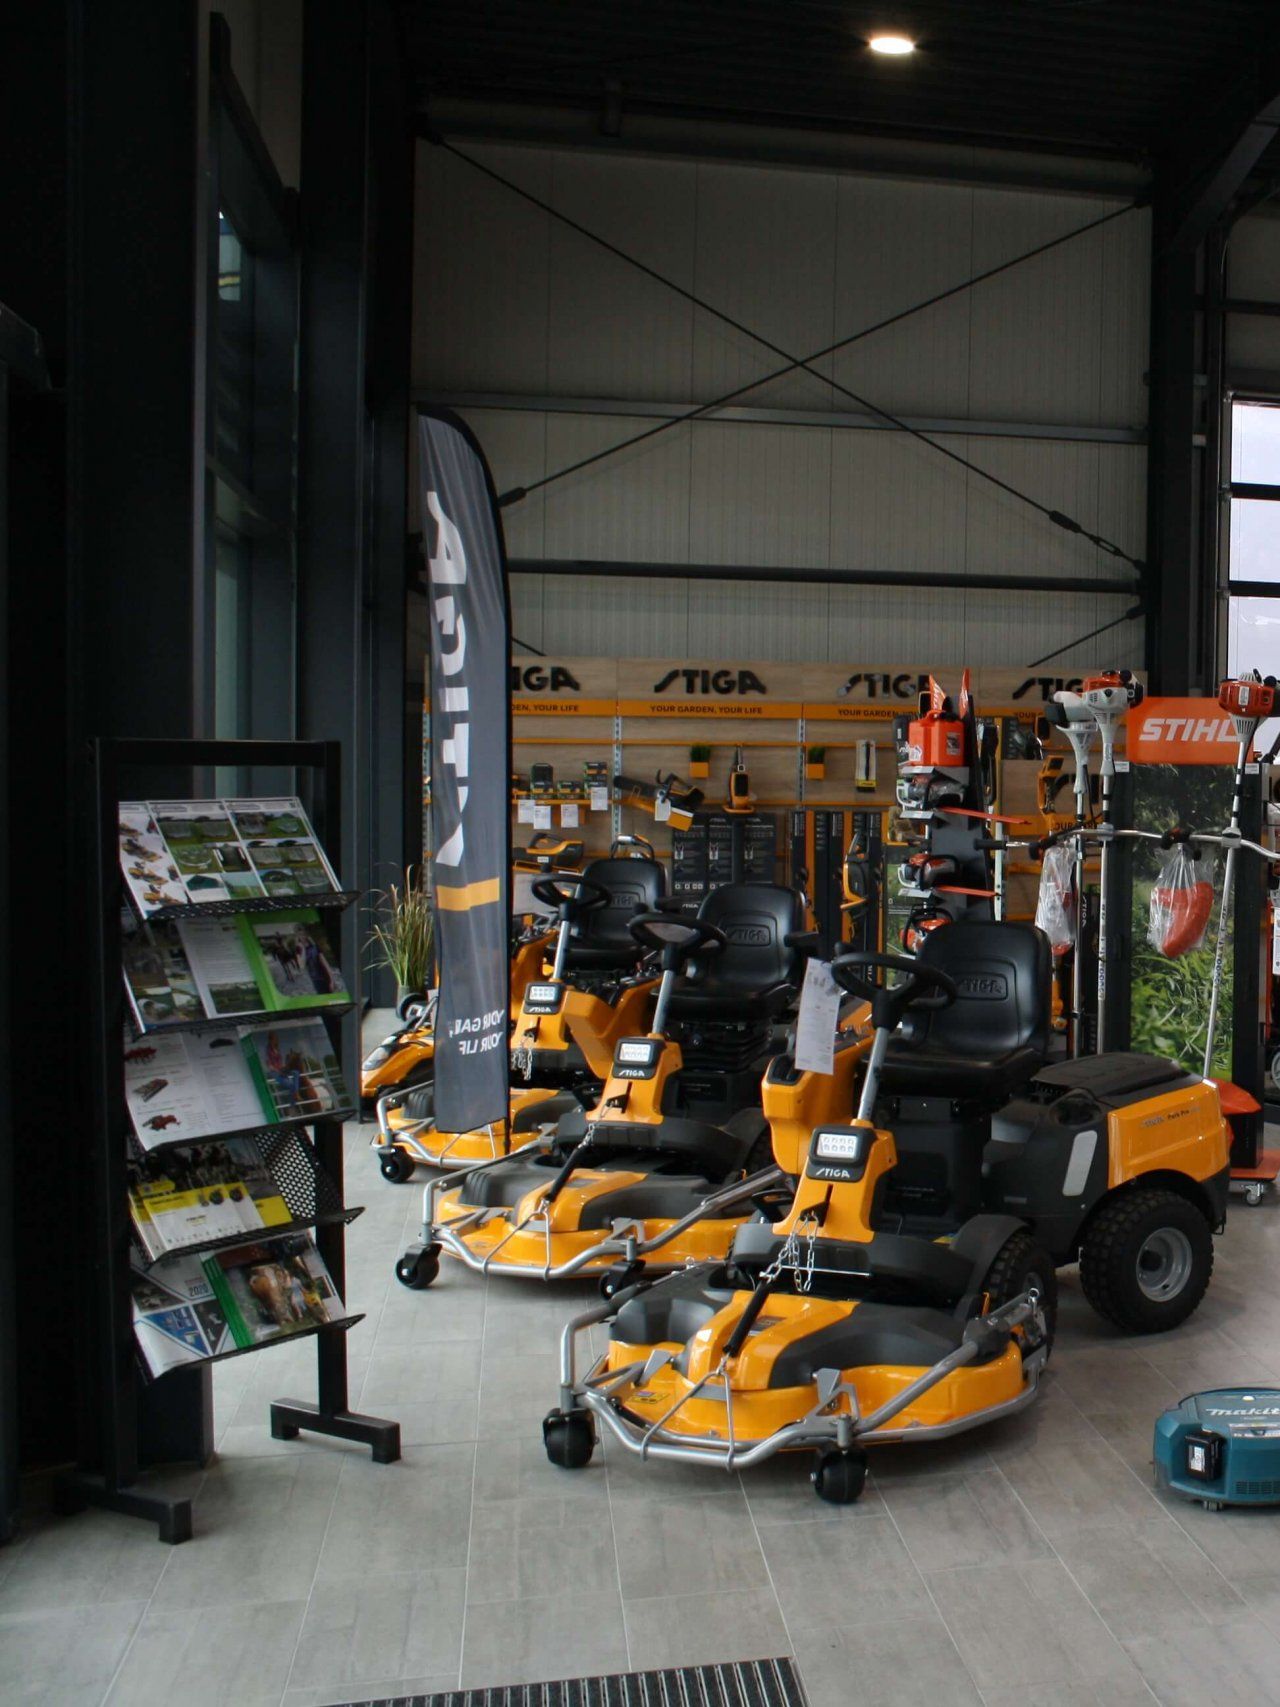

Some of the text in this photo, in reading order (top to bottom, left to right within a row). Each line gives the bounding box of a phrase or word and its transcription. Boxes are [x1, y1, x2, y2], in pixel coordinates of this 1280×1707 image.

[512, 666, 580, 691] IGA
[654, 669, 766, 695] STIGA
[1013, 676, 1084, 700] STIG
[512, 704, 531, 713] DEN,
[534, 704, 558, 712] YOUR
[651, 704, 762, 715] YOUR GARDEN, YOUR LIFE
[1139, 718, 1239, 742] STIHL
[618, 1069, 645, 1078] STIGA
[816, 1167, 850, 1178] STIGA
